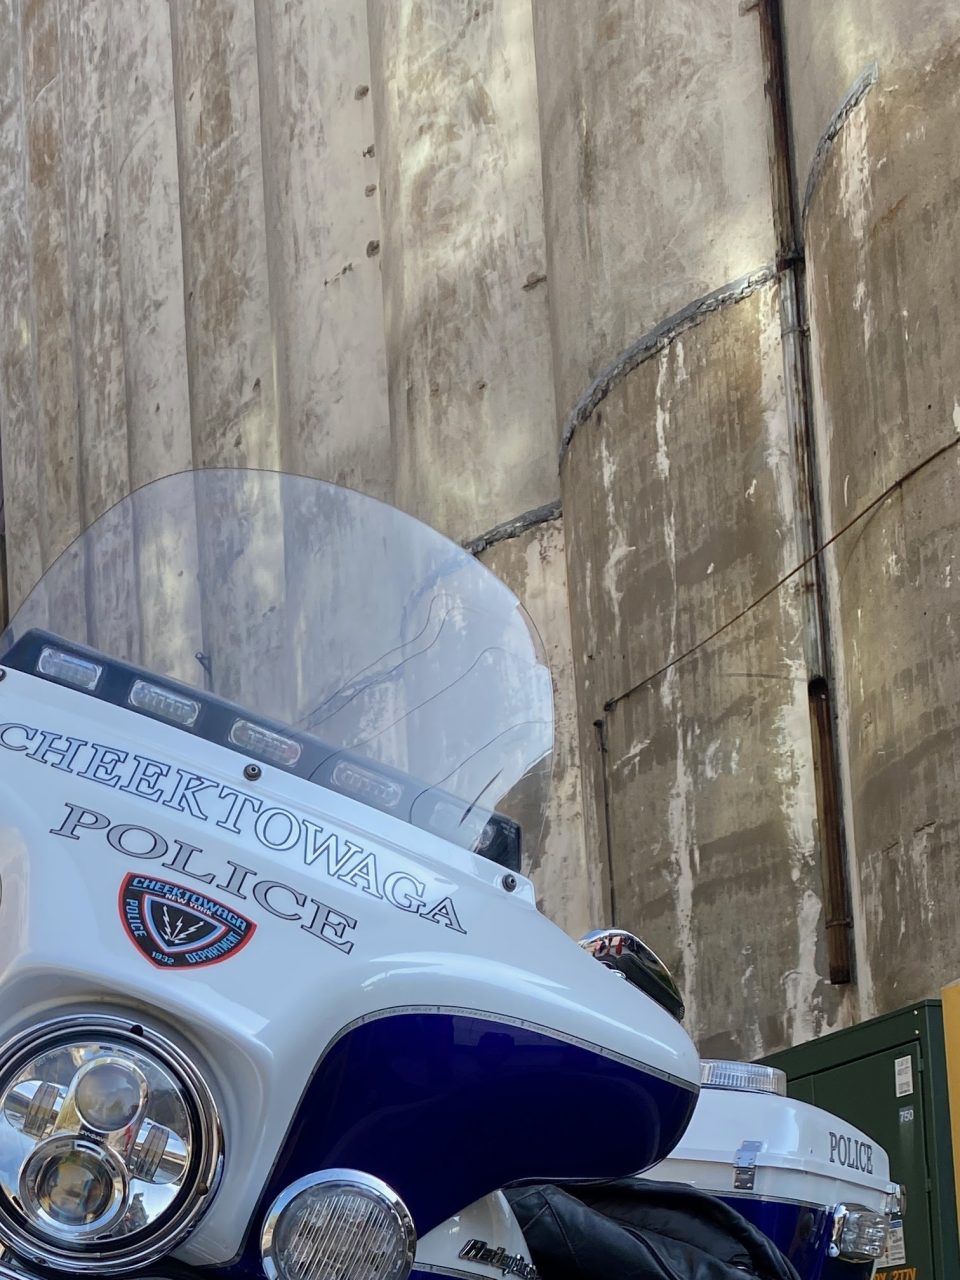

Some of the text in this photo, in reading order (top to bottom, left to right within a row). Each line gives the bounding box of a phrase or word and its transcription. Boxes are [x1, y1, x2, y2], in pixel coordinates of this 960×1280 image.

[49, 802, 358, 955] POLICE
[126, 898, 147, 938] POLICE
[132, 877, 247, 931] CHEEKTOWAGA
[165, 893, 213, 917] NEW YORK
[151, 951, 175, 965] 1932
[185, 931, 242, 964] DEPARTMENT
[899, 1109, 914, 1123] 750
[828, 1131, 873, 1175] POLICE
